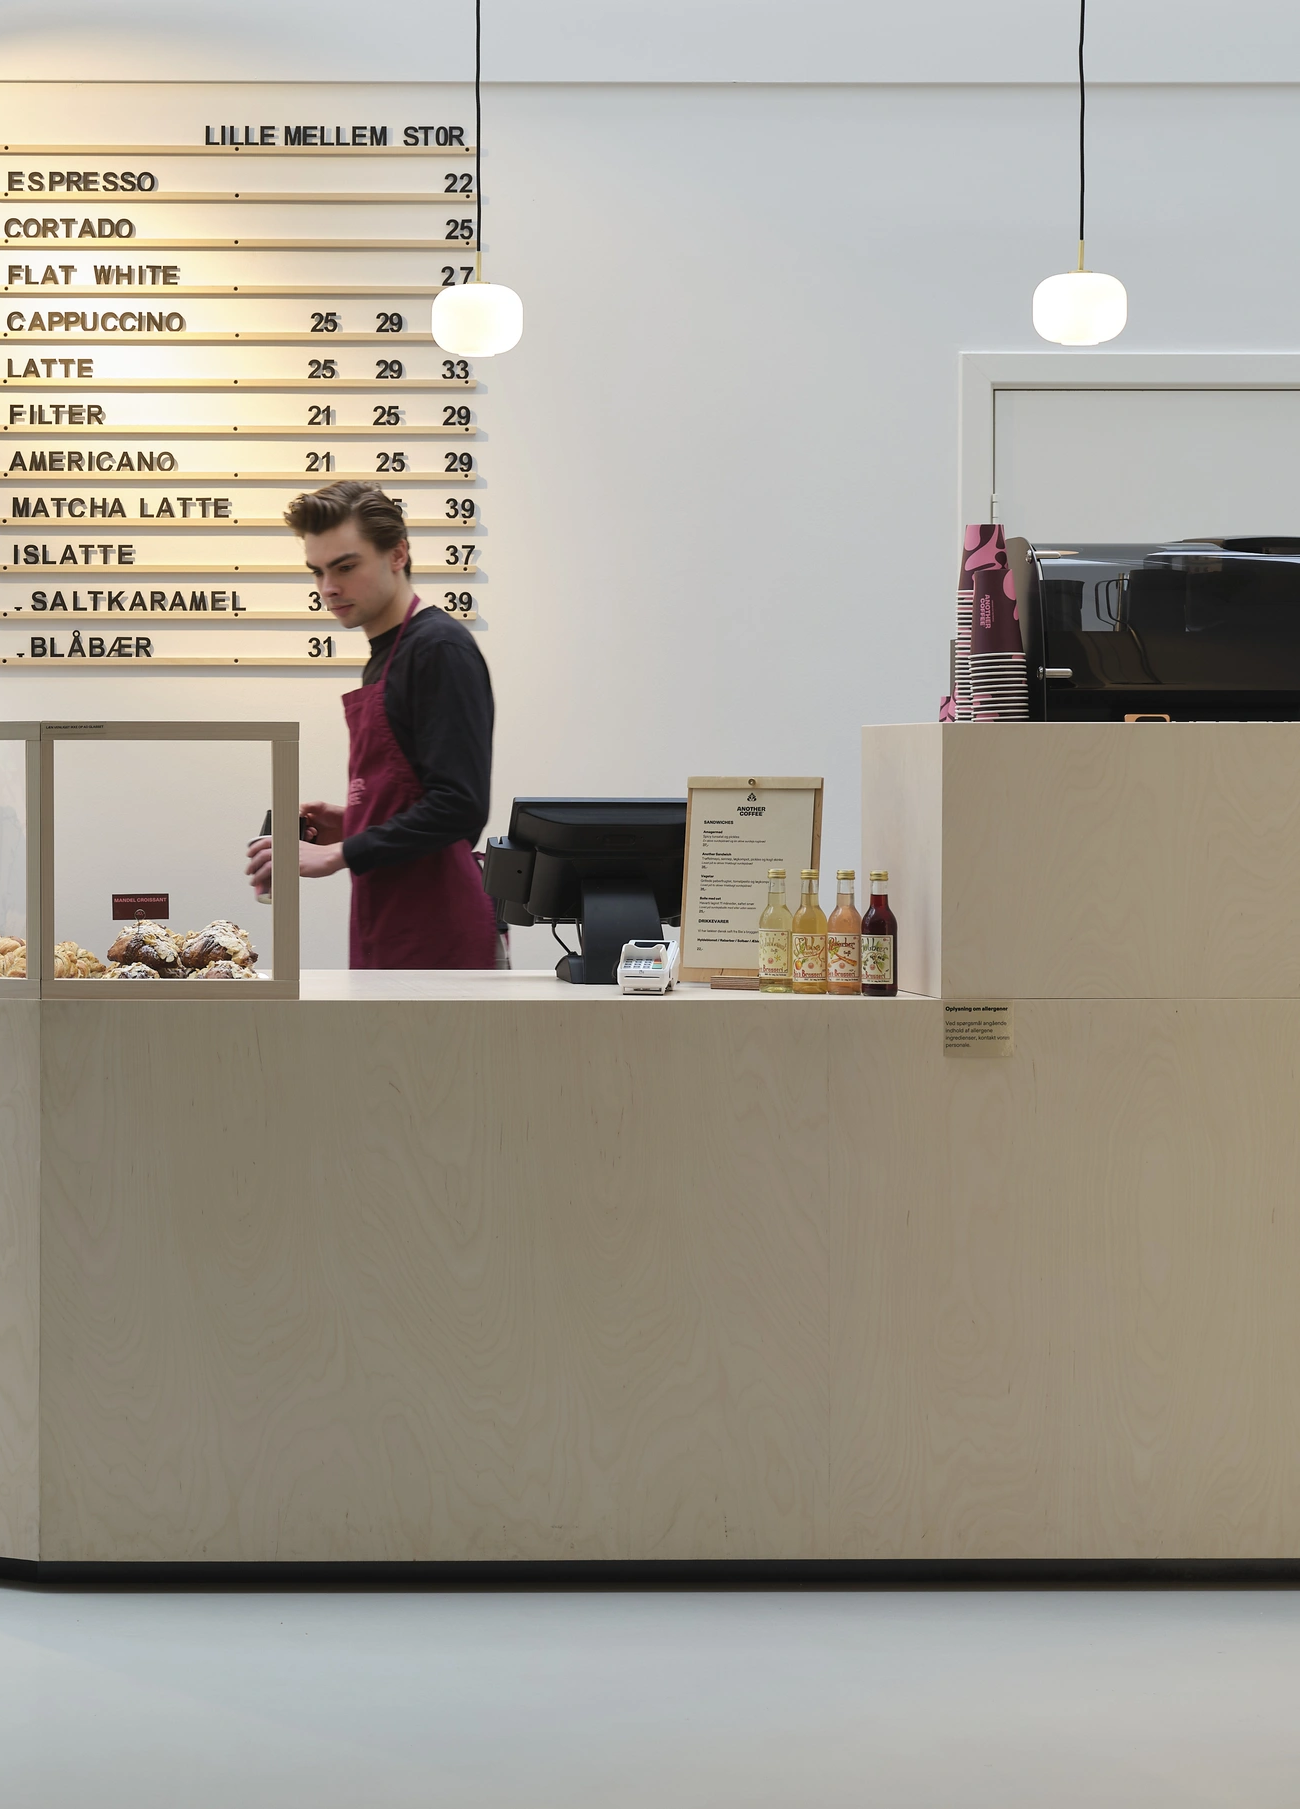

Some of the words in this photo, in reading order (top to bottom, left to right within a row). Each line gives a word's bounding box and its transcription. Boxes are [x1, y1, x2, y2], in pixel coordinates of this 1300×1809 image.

[205, 125, 276, 146] LILLE
[284, 126, 388, 146] MELLEM
[7, 171, 156, 192] ESPRESSO
[444, 173, 474, 193] 22
[4, 218, 134, 239] CORTADO
[445, 219, 474, 240] 25
[7, 264, 75, 285] FLAT
[94, 264, 179, 286] WHITE
[441, 266, 474, 286] 27
[6, 311, 184, 332] CAPPUCCINO
[310, 312, 338, 332] 25
[376, 312, 403, 332] 29
[7, 358, 93, 378] LATTE
[307, 359, 336, 379] 25
[376, 359, 402, 379] 29
[441, 359, 470, 380] 33
[9, 404, 103, 425] FILTER
[307, 405, 332, 426] 21
[372, 406, 400, 426] 25
[442, 406, 470, 426] 29
[9, 450, 176, 472] AMERICANO
[305, 452, 332, 472] 21
[376, 452, 405, 472] 25
[444, 452, 473, 472] 29
[12, 497, 126, 518] MATCHA
[140, 497, 230, 518] LATTE
[445, 498, 475, 518] 39
[13, 544, 134, 565] ISLATTE
[446, 544, 476, 565] 37
[31, 590, 246, 612] SALTKARAMEL
[444, 592, 472, 612] 39
[30, 629, 152, 658] BLÅBÆR
[308, 636, 332, 658] 31
